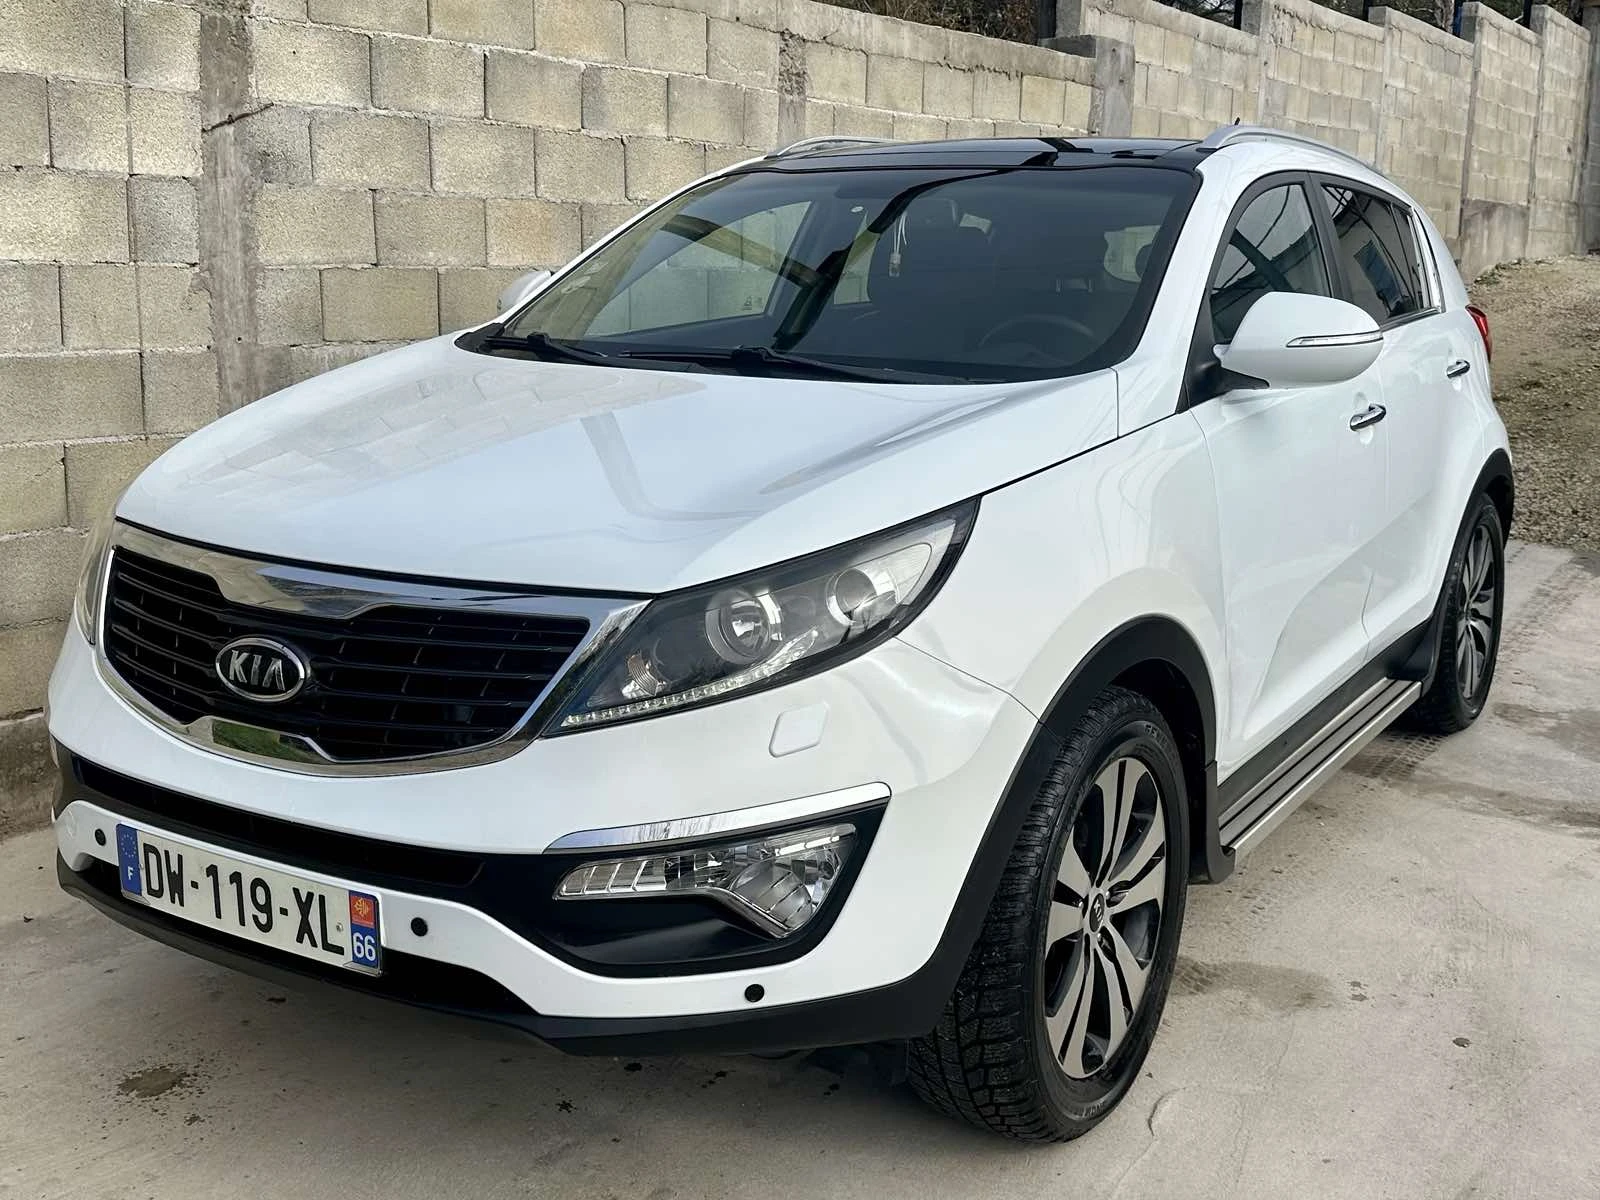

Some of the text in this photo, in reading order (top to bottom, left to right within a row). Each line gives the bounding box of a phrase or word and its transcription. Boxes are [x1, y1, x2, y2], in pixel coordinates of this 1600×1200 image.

[229, 649, 285, 691] KIA
[127, 866, 133, 880] F
[142, 842, 345, 956] DW-119-XL
[353, 932, 376, 961] 66
